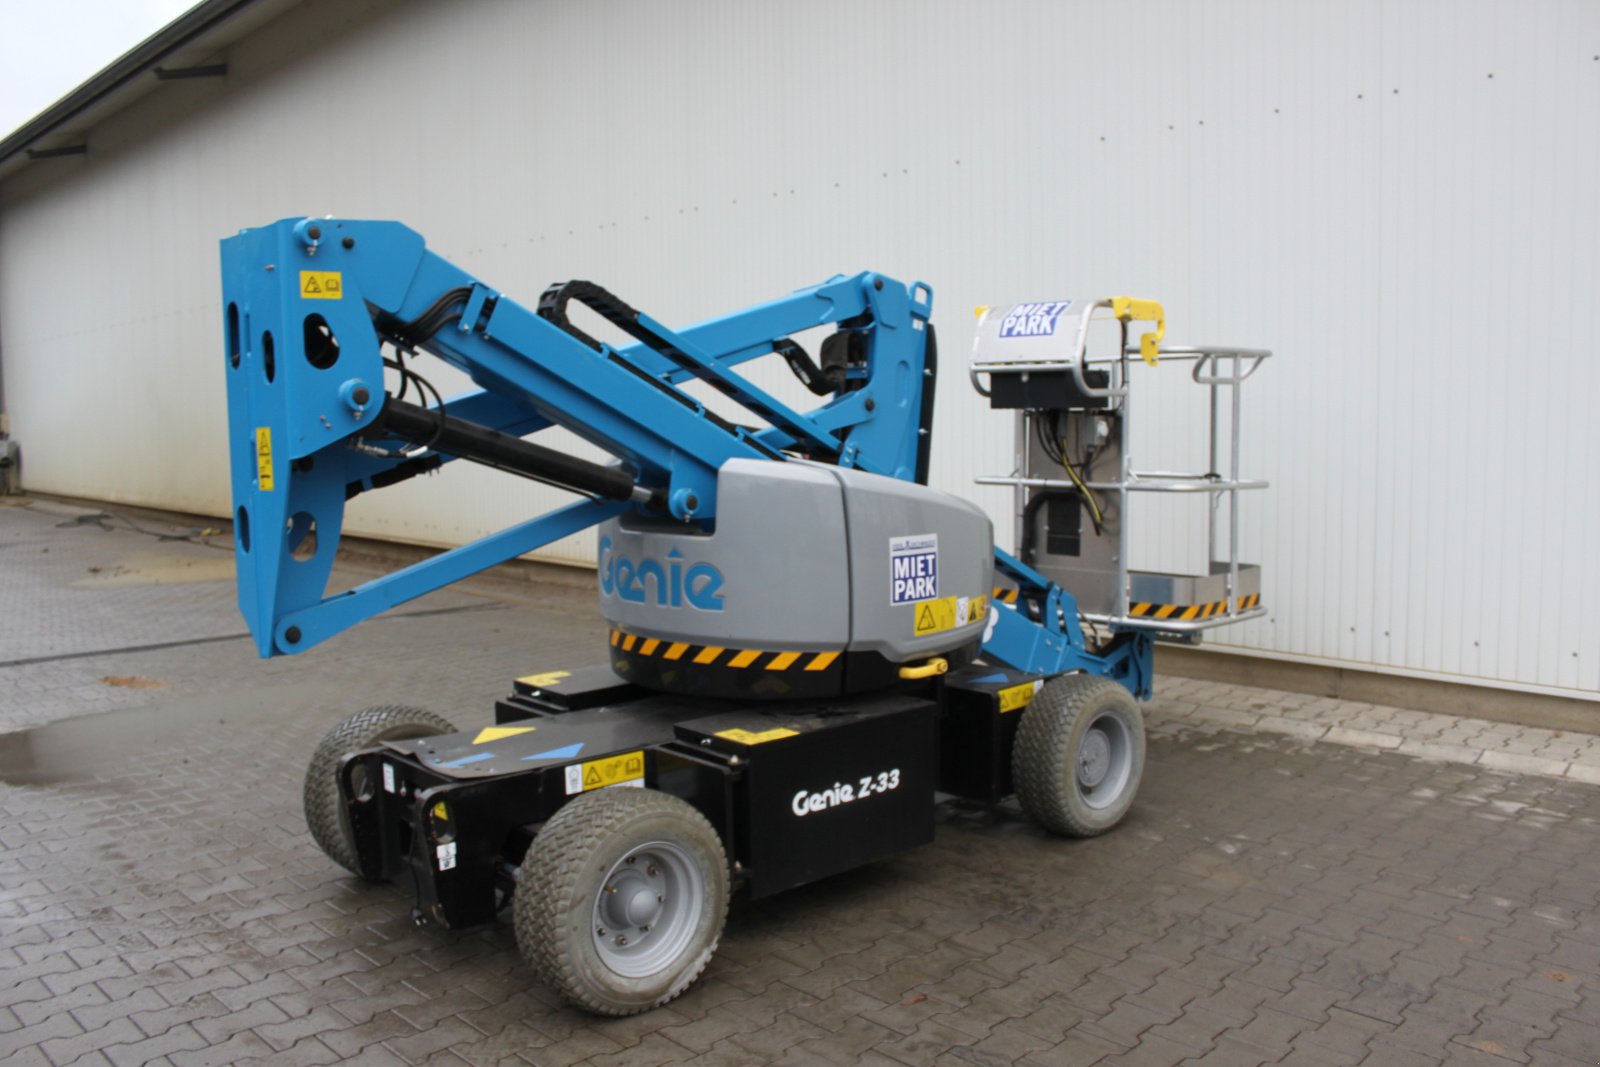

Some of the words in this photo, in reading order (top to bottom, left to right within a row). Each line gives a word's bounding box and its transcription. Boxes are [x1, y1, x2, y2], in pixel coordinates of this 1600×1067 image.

[1012, 301, 1067, 317] MIET
[1001, 316, 1055, 336] PARK
[599, 534, 725, 613] Genie
[894, 555, 936, 579] MIET
[894, 577, 936, 601] PARK
[792, 782, 855, 816] Genie
[857, 768, 901, 799] Z-33
